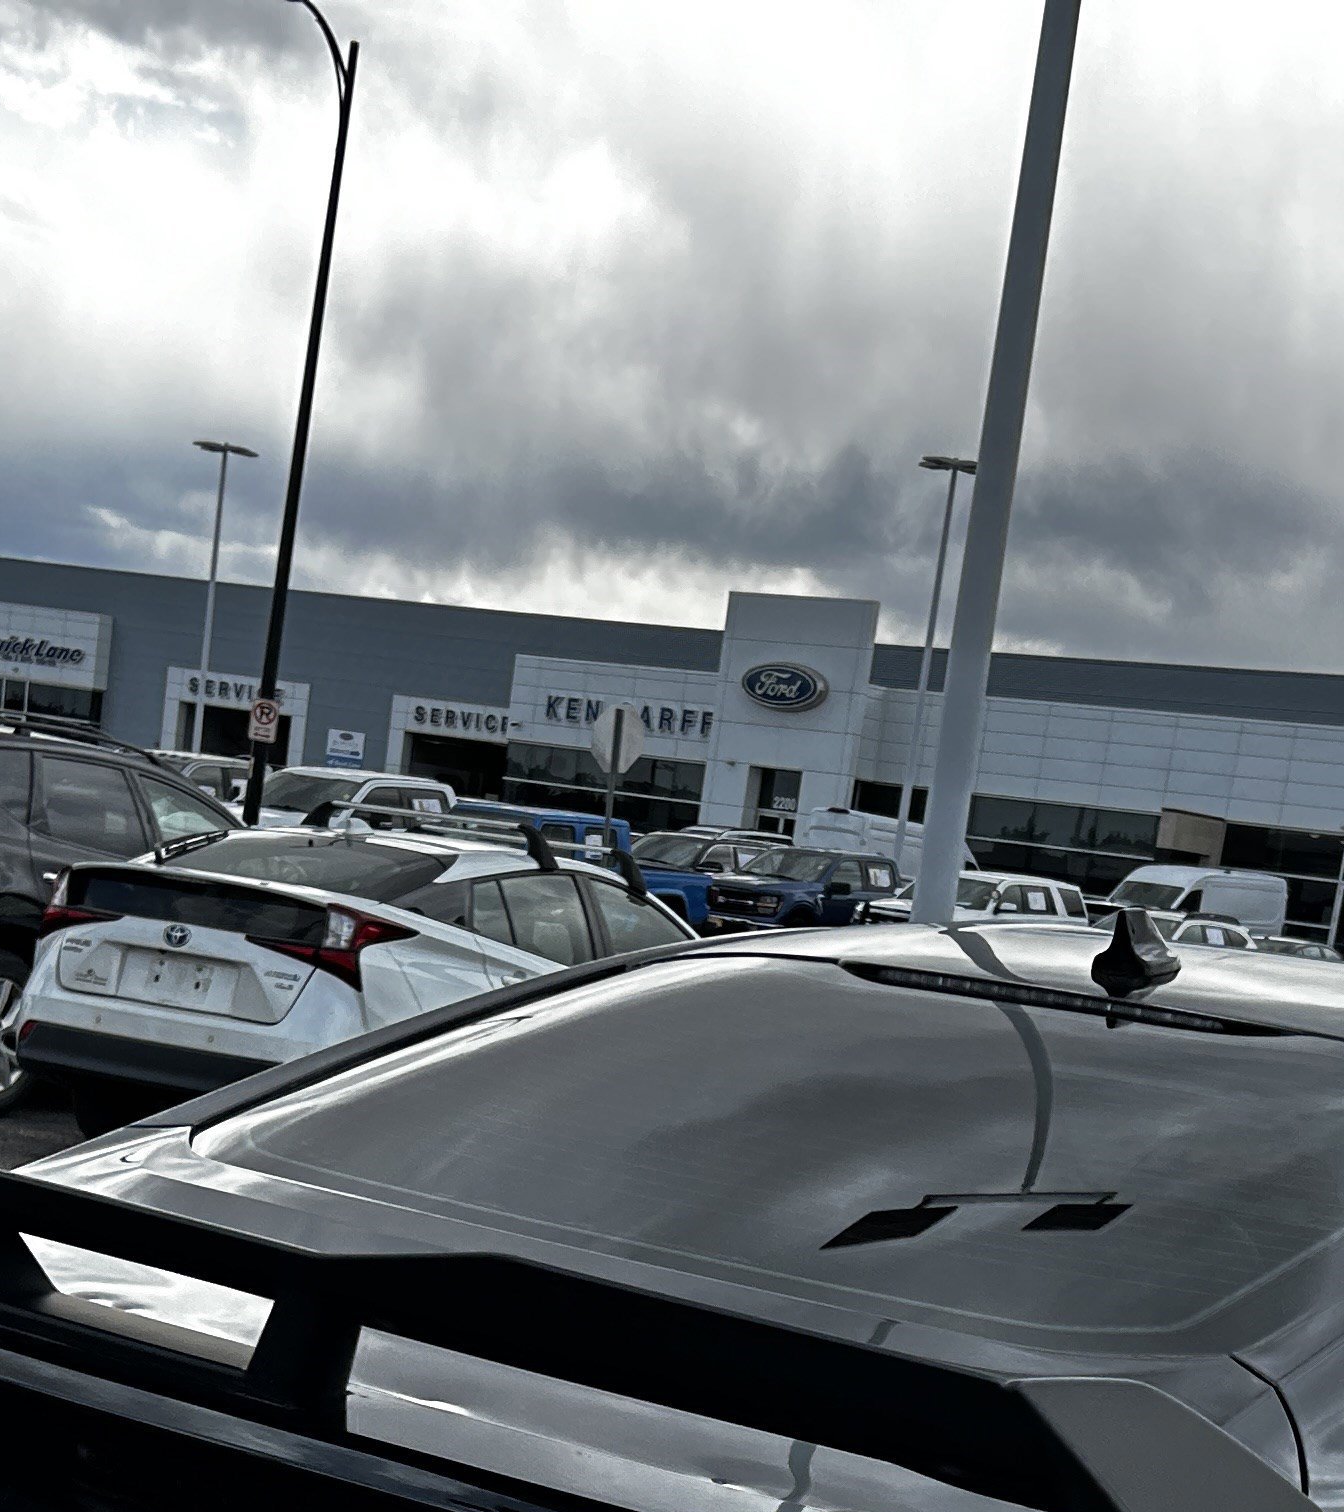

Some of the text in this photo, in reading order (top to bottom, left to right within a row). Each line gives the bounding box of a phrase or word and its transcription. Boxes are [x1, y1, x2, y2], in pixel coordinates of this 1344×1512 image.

[34, 640, 84, 664] Lane
[754, 670, 802, 699] Ford
[545, 694, 714, 737] KEN ARFF
